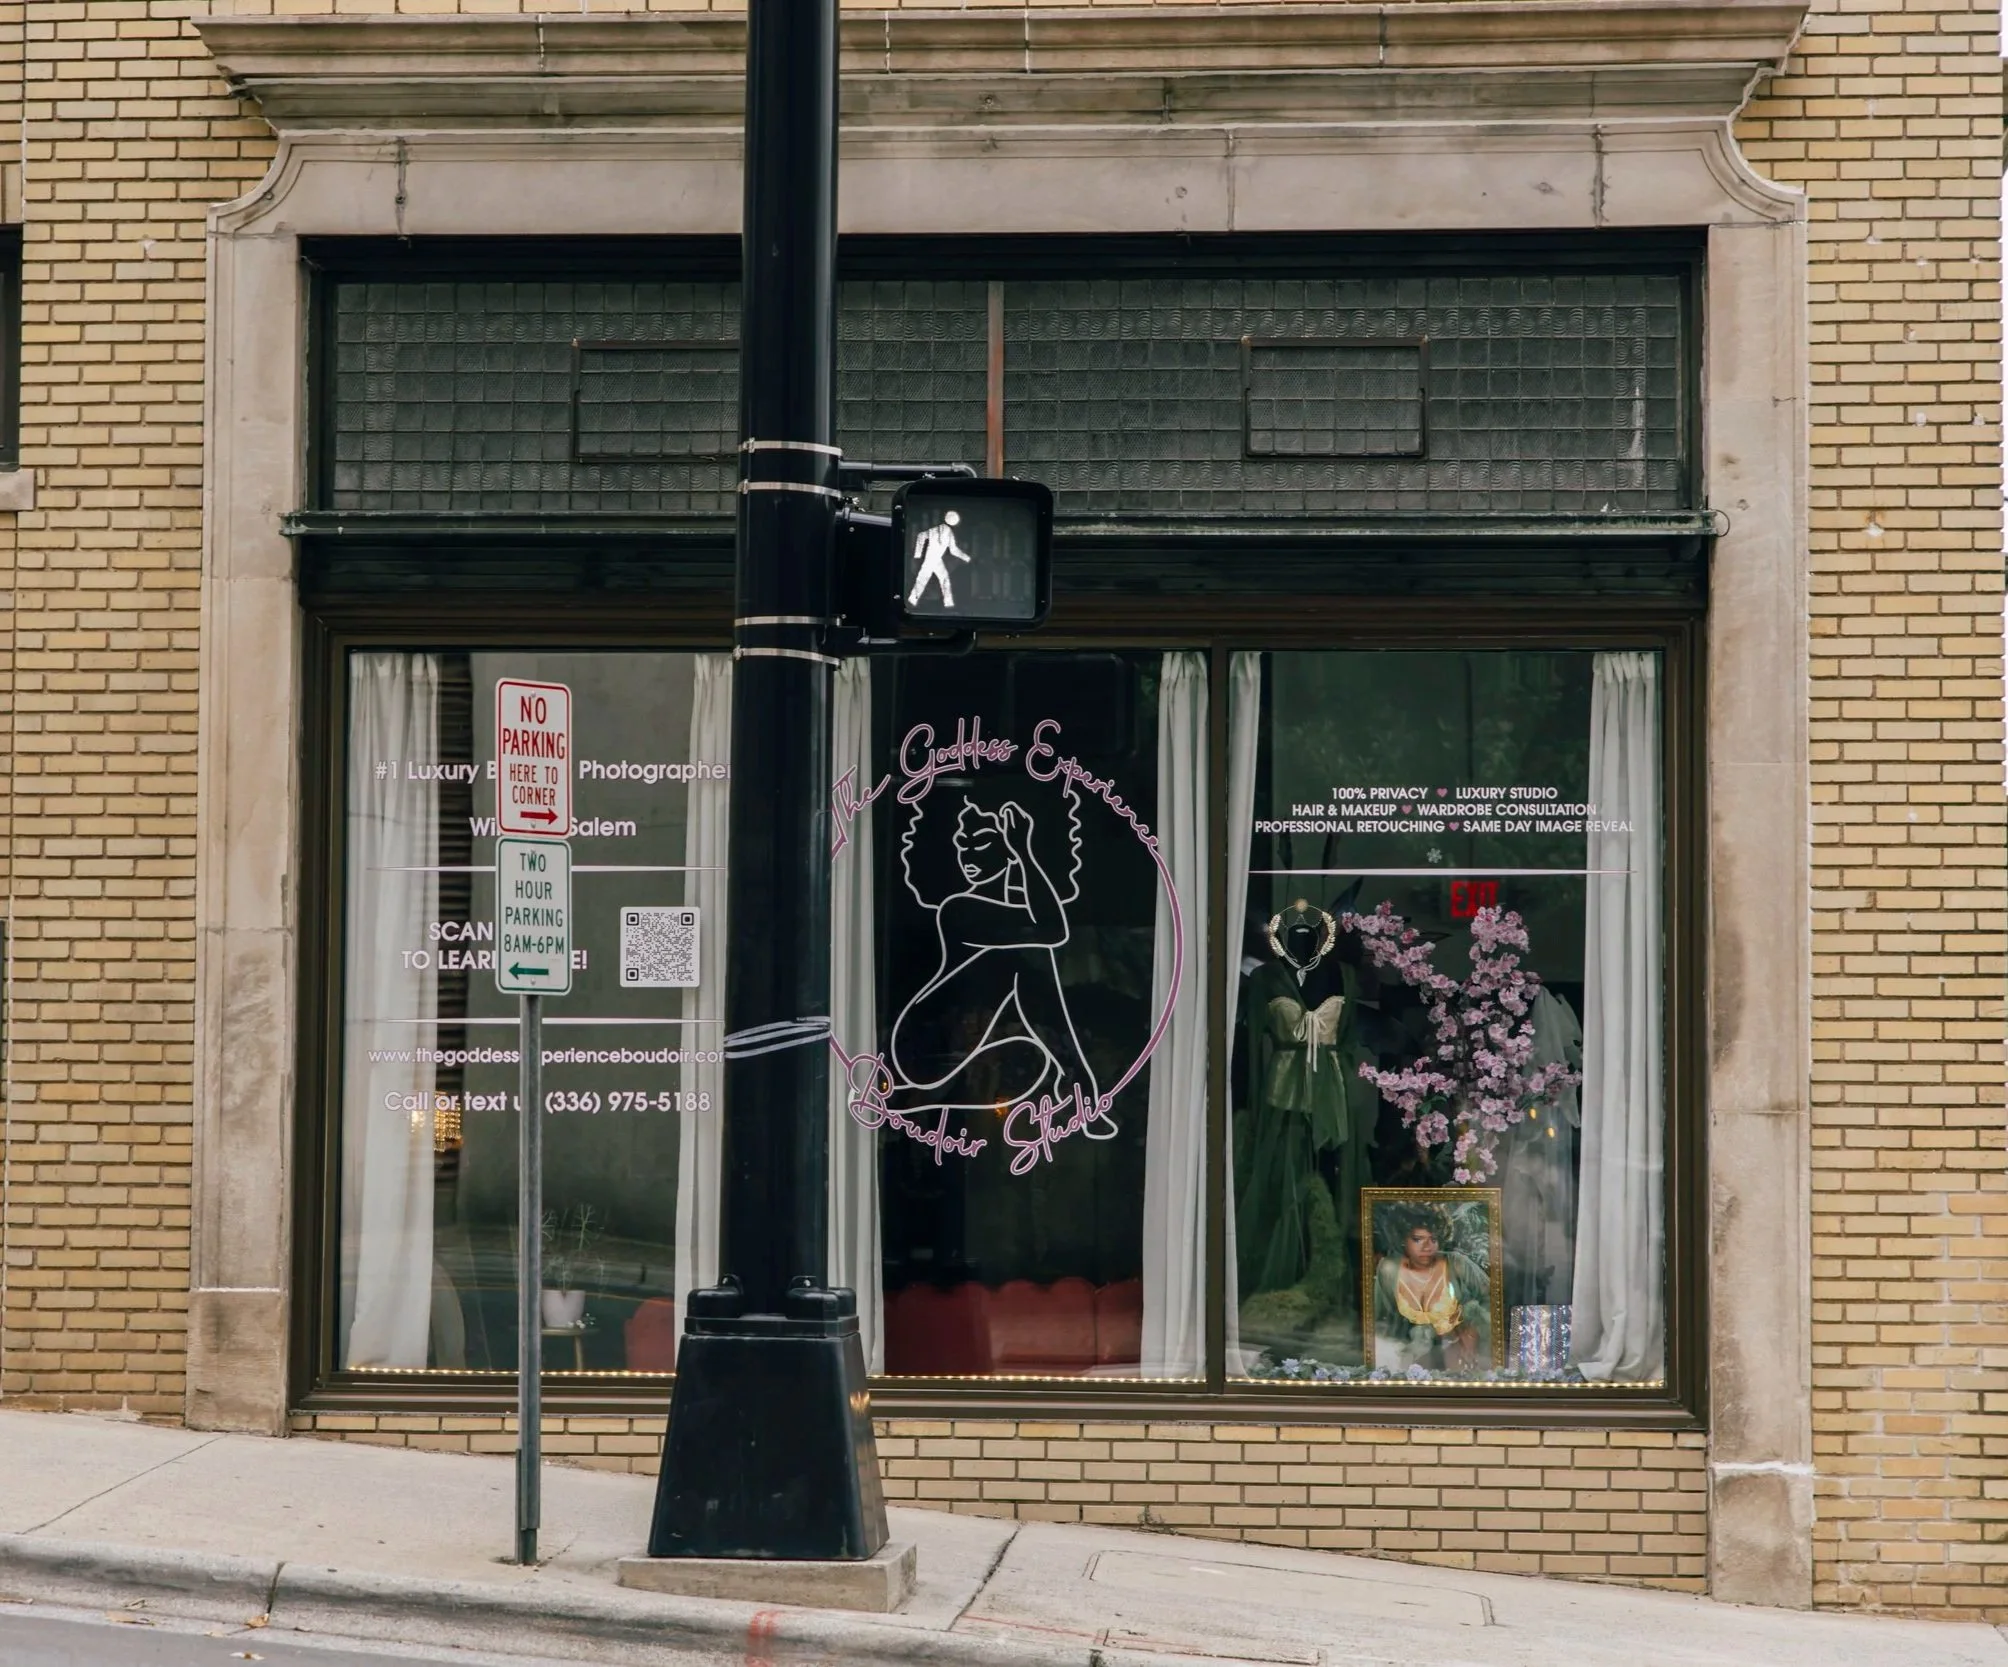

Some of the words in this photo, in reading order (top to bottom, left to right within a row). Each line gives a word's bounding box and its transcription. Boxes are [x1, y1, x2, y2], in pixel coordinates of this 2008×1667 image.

[520, 695, 547, 725] NO
[502, 728, 566, 760] PARKING
[375, 760, 398, 780] #1
[408, 760, 480, 784] Luxury
[509, 763, 537, 784] HERE
[544, 766, 559, 786] TO
[512, 785, 556, 807] CORNER
[832, 764, 891, 862] The
[897, 715, 1018, 803] Goddess
[1025, 719, 1159, 847] Experience
[1331, 787, 1367, 800] 100%
[1370, 787, 1429, 800] PRIVACY
[1456, 787, 1507, 799] LUXURY
[1509, 787, 1559, 800] STUDIO
[1292, 803, 1325, 816] HAIR
[1328, 804, 1338, 816] &
[1341, 803, 1398, 816] MAKEUP
[1417, 804, 1492, 816] WARDROBE
[1495, 803, 1597, 816] CONSULTATION
[1255, 820, 1354, 833] PROFESSIONAL
[1356, 820, 1446, 833] RETOUCHING
[1463, 820, 1501, 832] SAME
[1505, 820, 1534, 832] DAY
[1536, 820, 1583, 833] IMAGE
[1585, 820, 1635, 832] REVEAL
[519, 852, 547, 873] TWO
[515, 880, 553, 901] HOUR
[1451, 880, 1499, 918] EXIT
[505, 906, 564, 928] PARKING
[429, 921, 494, 942] SCAN
[503, 934, 565, 955] 8AM-6PM
[402, 950, 430, 970] TO
[368, 1047, 724, 1068] www.thegoddessperienceboudoir.co
[384, 1091, 429, 1111] Call
[434, 1094, 459, 1111] or
[463, 1091, 508, 1111] text
[544, 1091, 601, 1114] (336)
[607, 1091, 711, 1112] 975-5188
[849, 1052, 988, 1166] Boudoir
[1003, 1082, 1113, 1175] Studio
